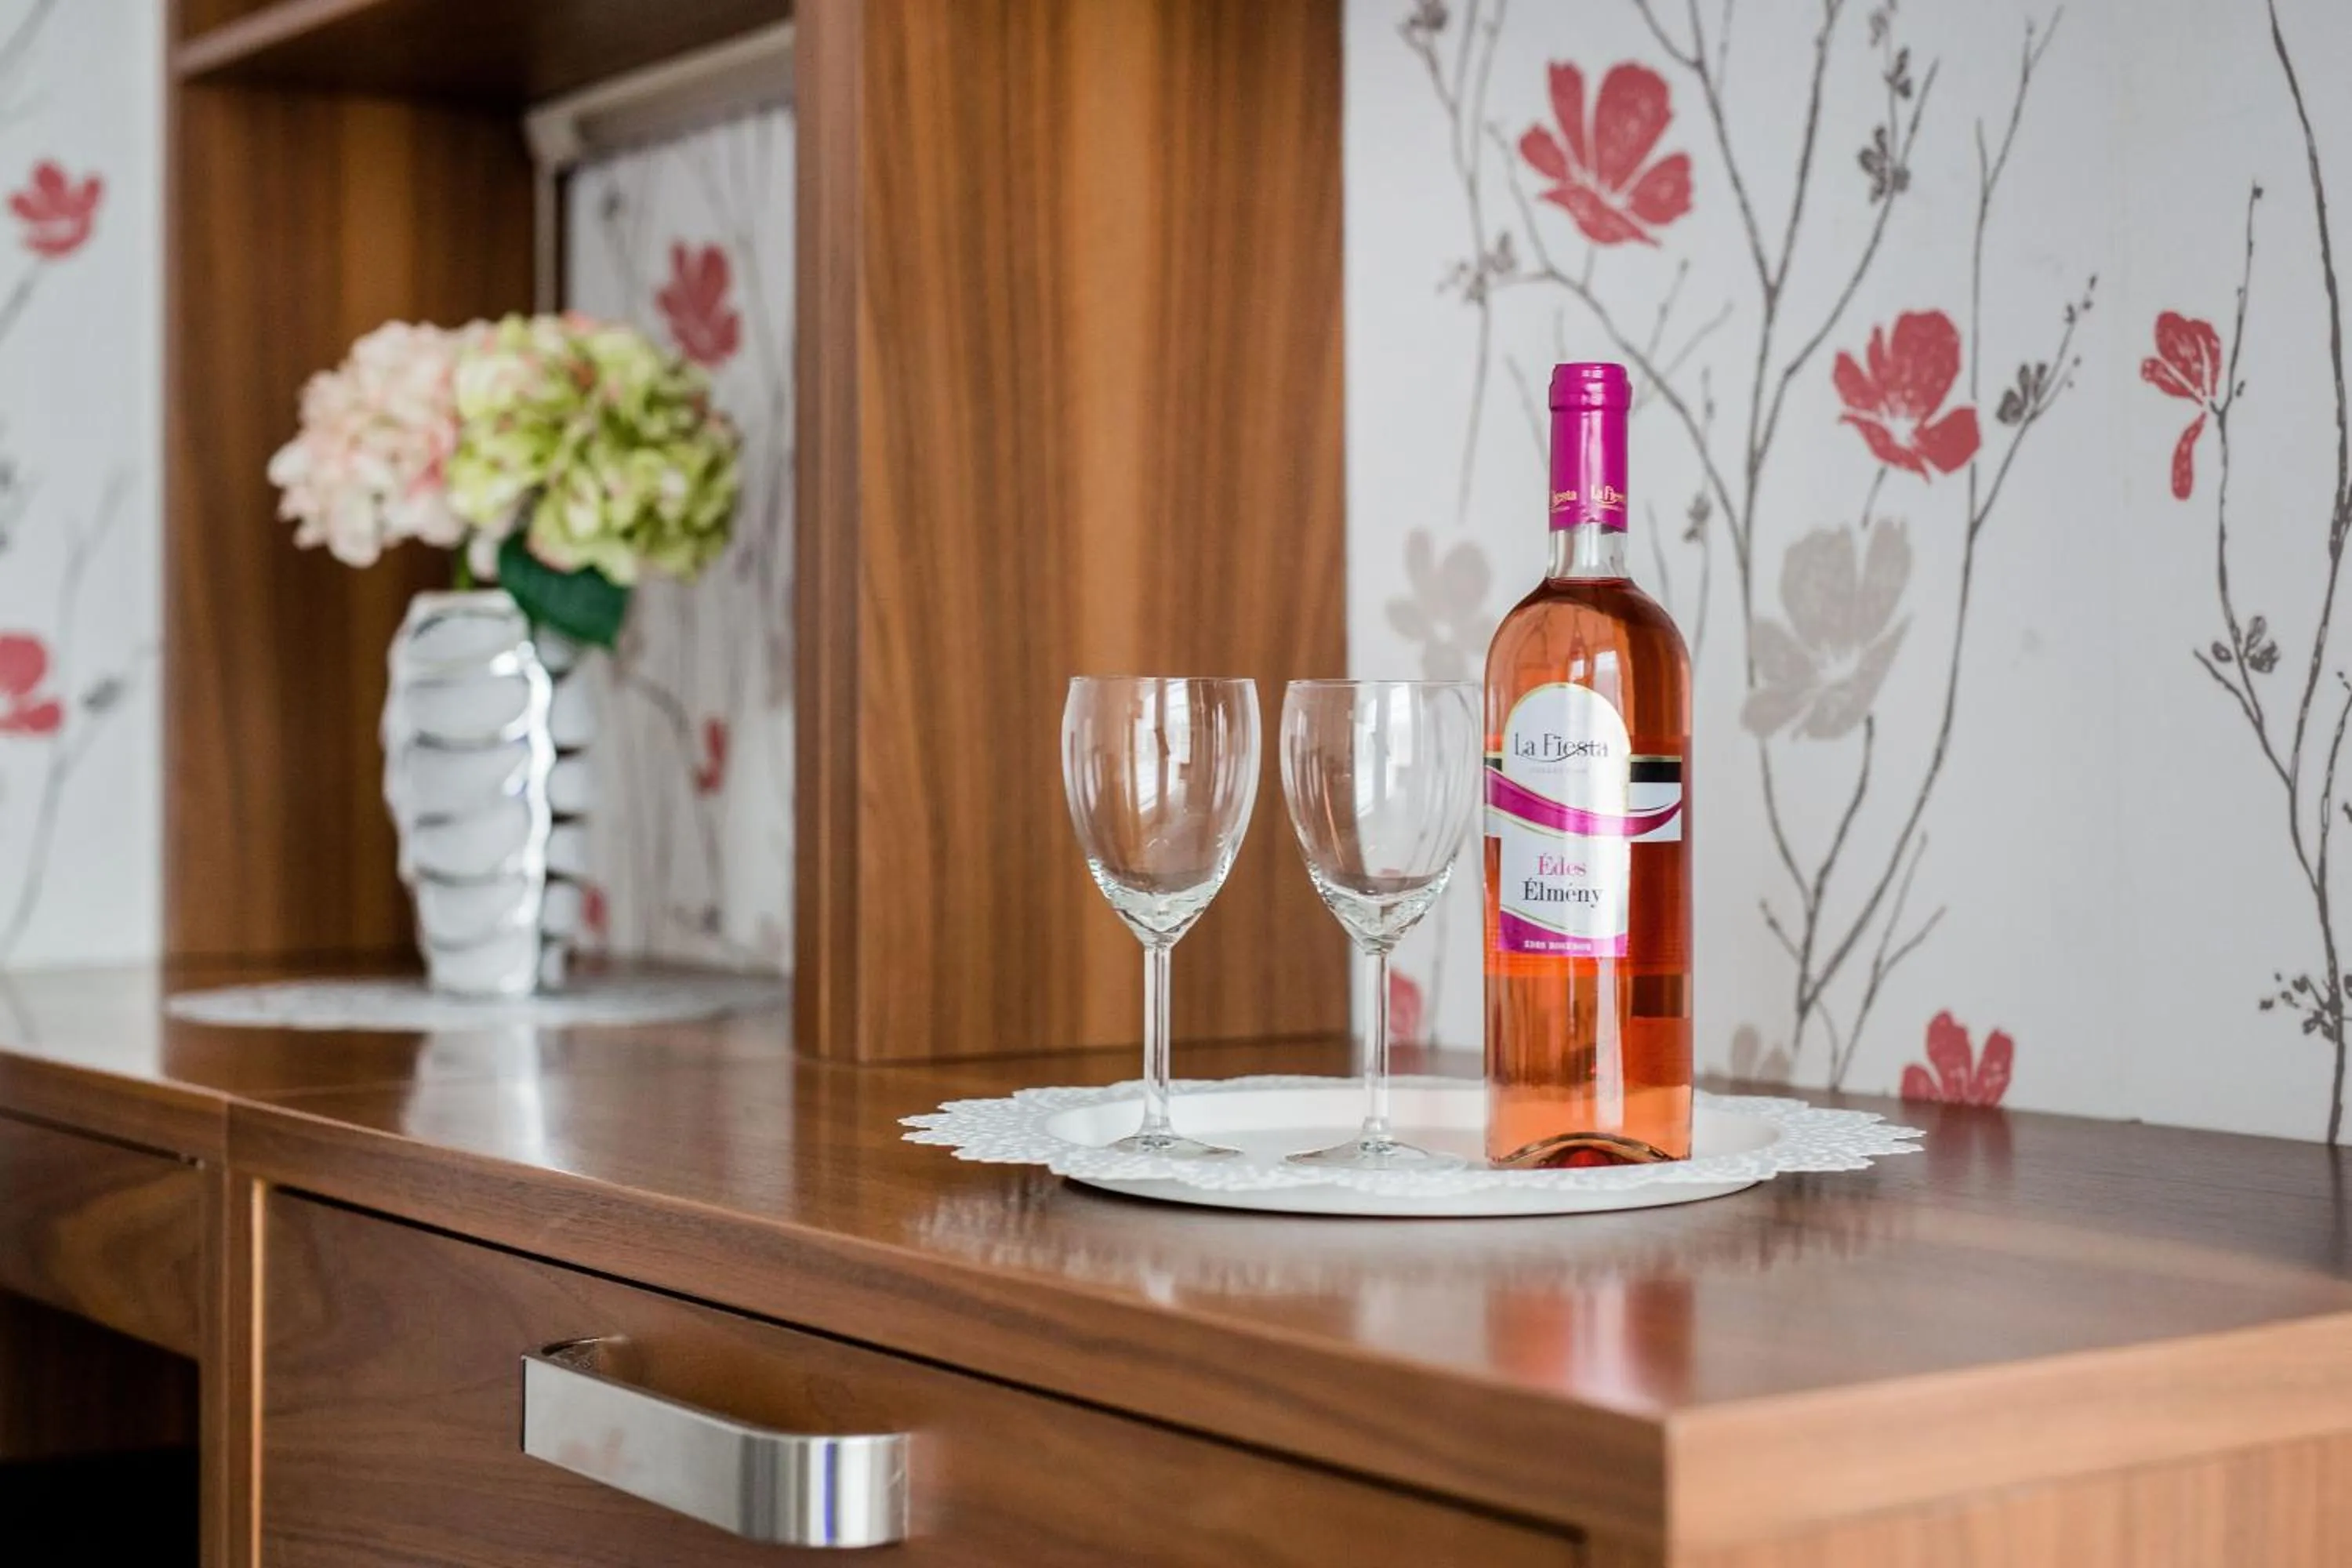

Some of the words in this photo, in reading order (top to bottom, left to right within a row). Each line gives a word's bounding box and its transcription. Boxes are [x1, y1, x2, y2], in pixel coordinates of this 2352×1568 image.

[1515, 732, 1535, 756] La
[1543, 733, 1608, 757] Fiesta
[1537, 853, 1587, 877] Édes
[1522, 877, 1603, 908] Élmény
